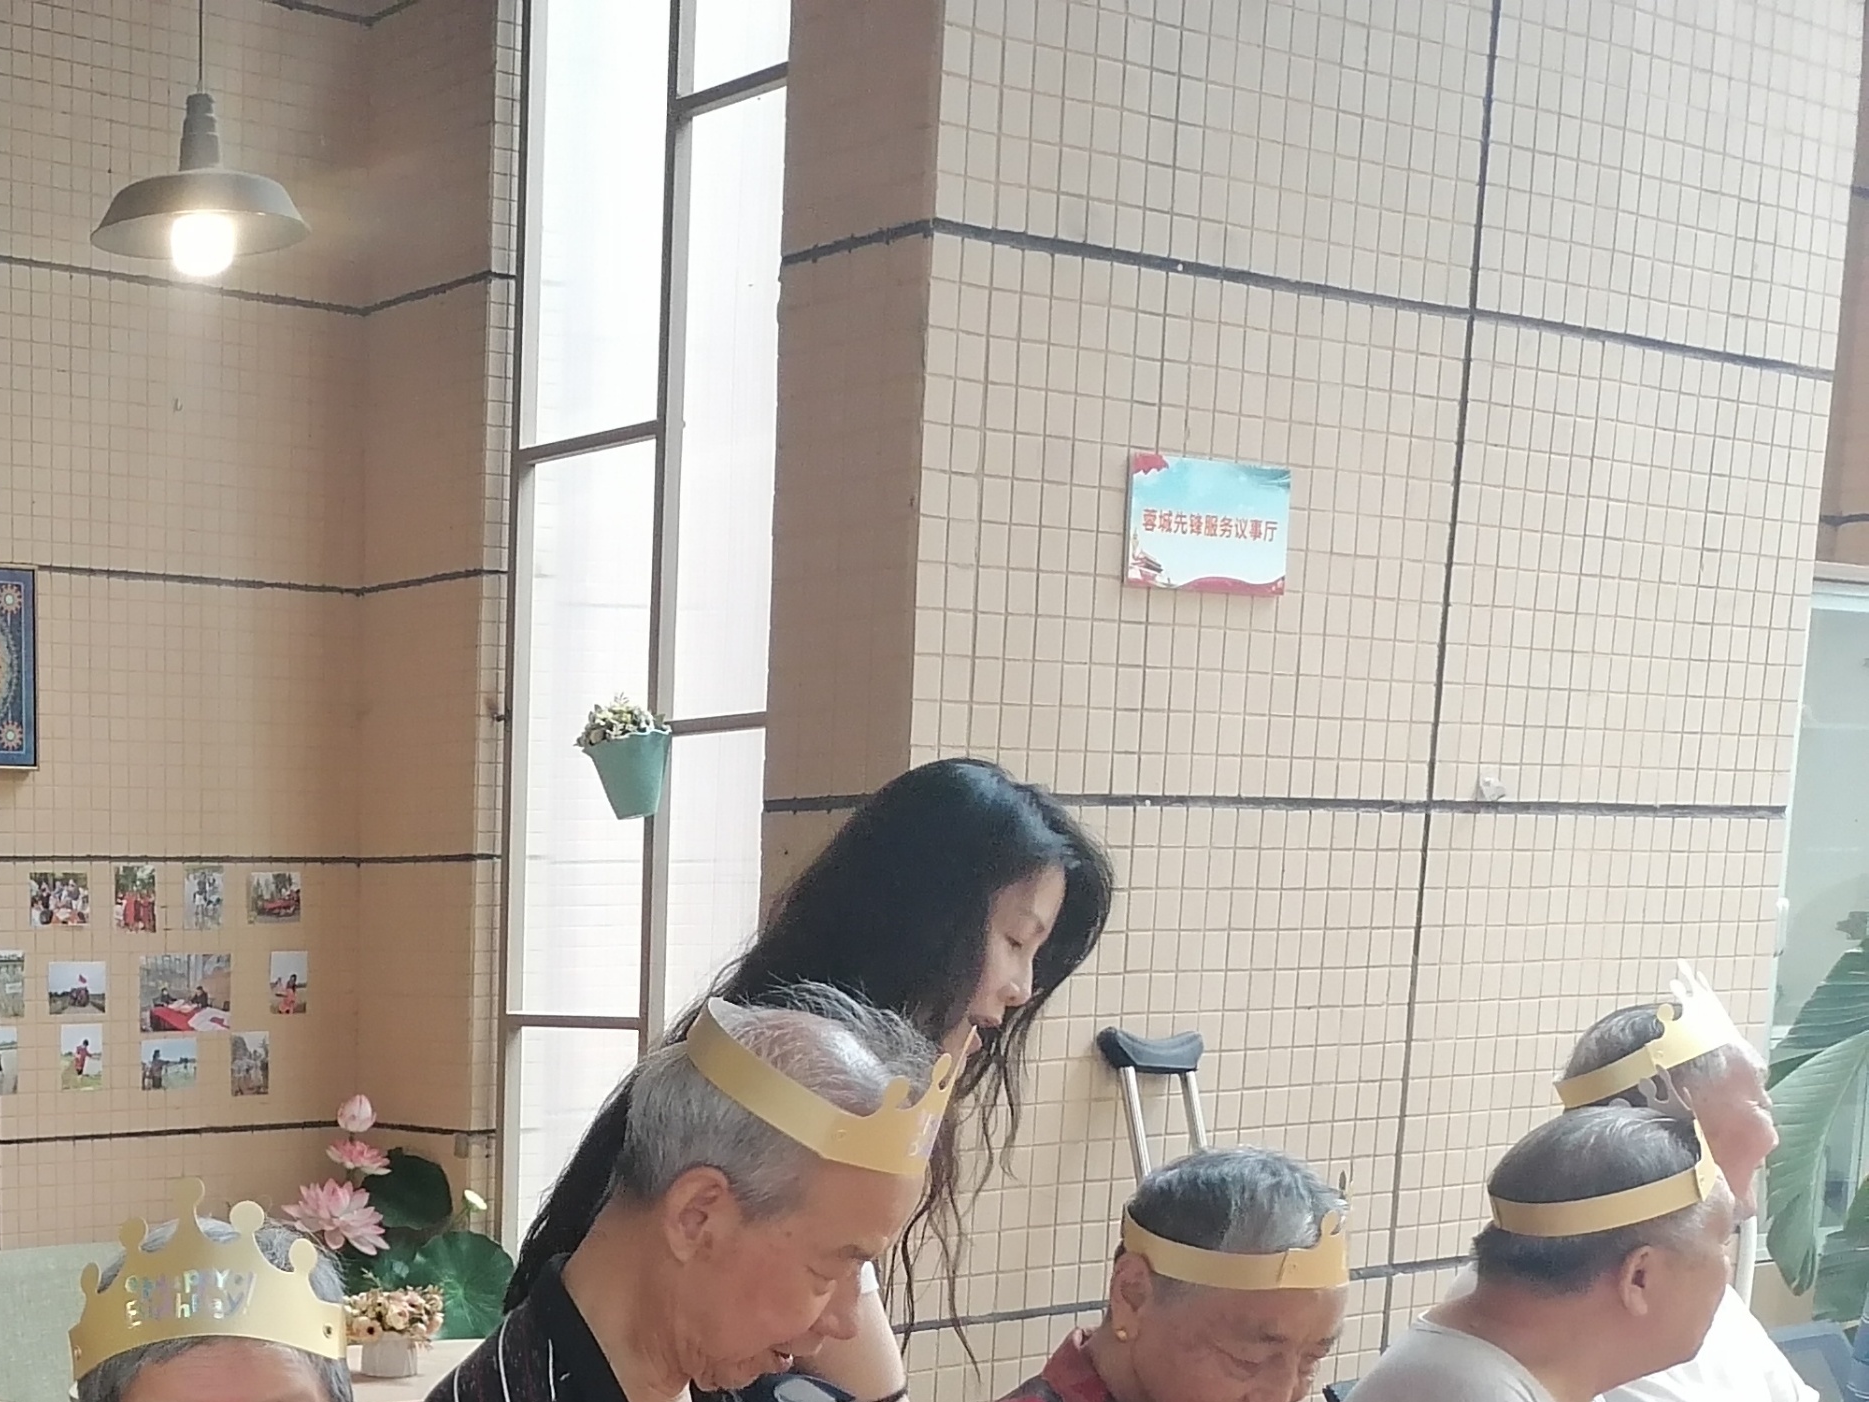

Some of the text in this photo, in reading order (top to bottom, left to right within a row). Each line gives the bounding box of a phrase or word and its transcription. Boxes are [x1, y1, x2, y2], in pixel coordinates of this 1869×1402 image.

[1142, 507, 1279, 543] 蓉城先锋服务议事厅
